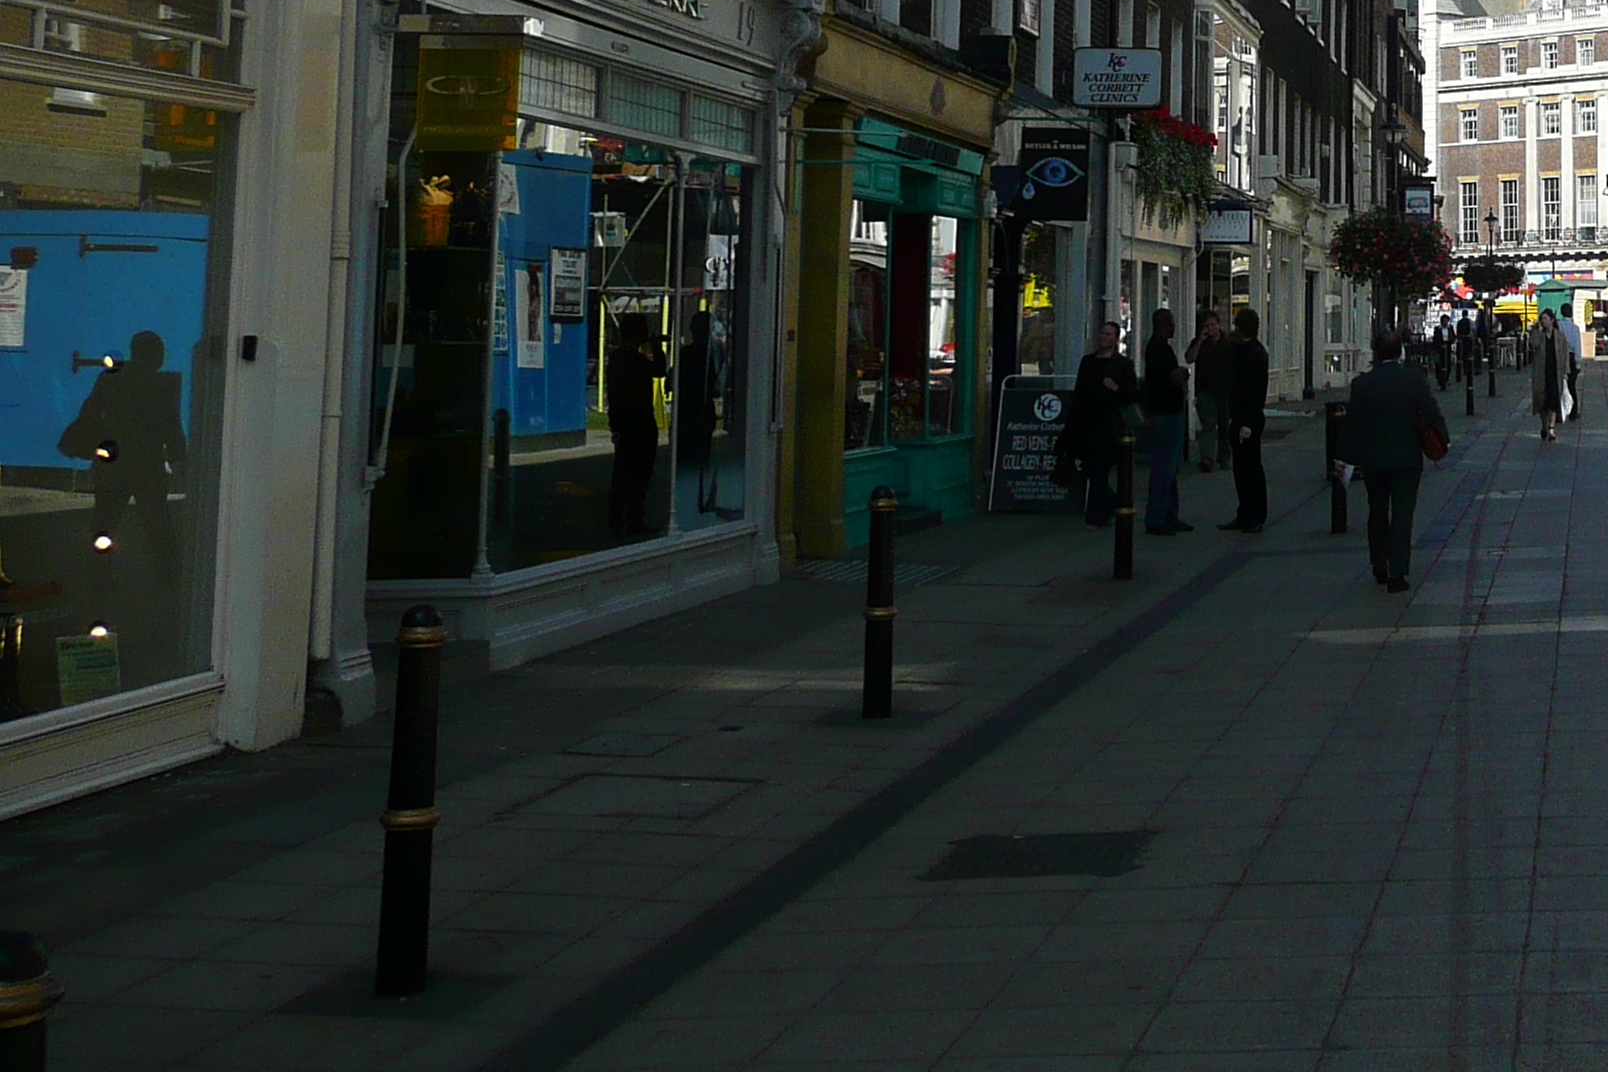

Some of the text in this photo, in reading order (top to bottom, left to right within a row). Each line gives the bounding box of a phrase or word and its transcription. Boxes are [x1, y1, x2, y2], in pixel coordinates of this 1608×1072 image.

[737, 2, 755, 47] 19
[1083, 73, 1151, 83] KATHERINE
[1088, 83, 1144, 93] CORBETT
[1090, 93, 1139, 103] CLINICS
[1059, 143, 1087, 151] WILSON
